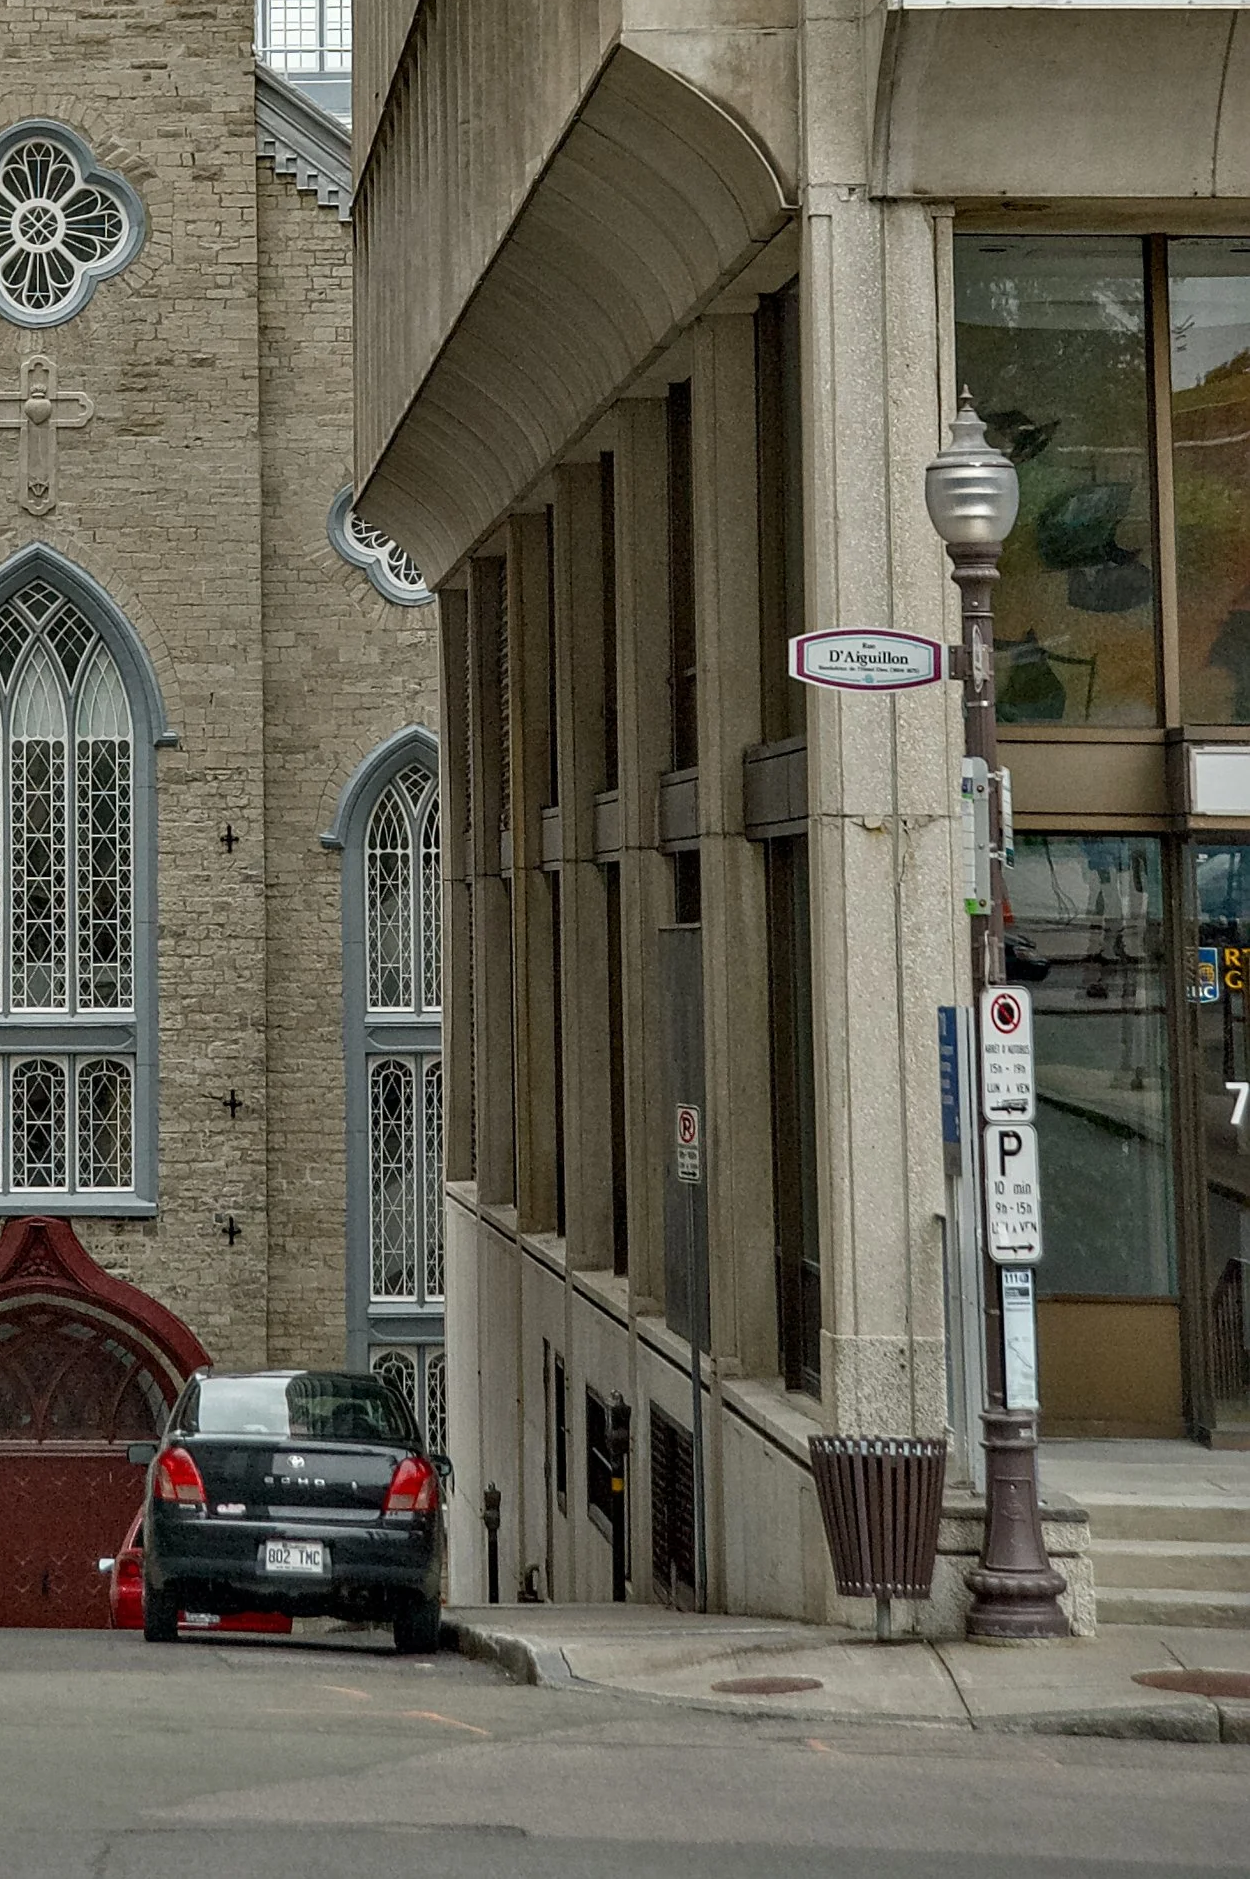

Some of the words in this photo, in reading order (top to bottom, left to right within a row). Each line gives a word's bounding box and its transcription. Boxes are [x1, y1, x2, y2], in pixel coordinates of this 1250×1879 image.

[829, 649, 909, 667] D'Aiguillon
[998, 1130, 1022, 1177] P
[994, 1180, 1005, 1195] 10
[1013, 1180, 1032, 1195] min
[995, 1202, 1008, 1214] 9h
[1016, 1202, 1032, 1215] 15h
[268, 1548, 291, 1564] 802
[298, 1549, 320, 1566] TMC
